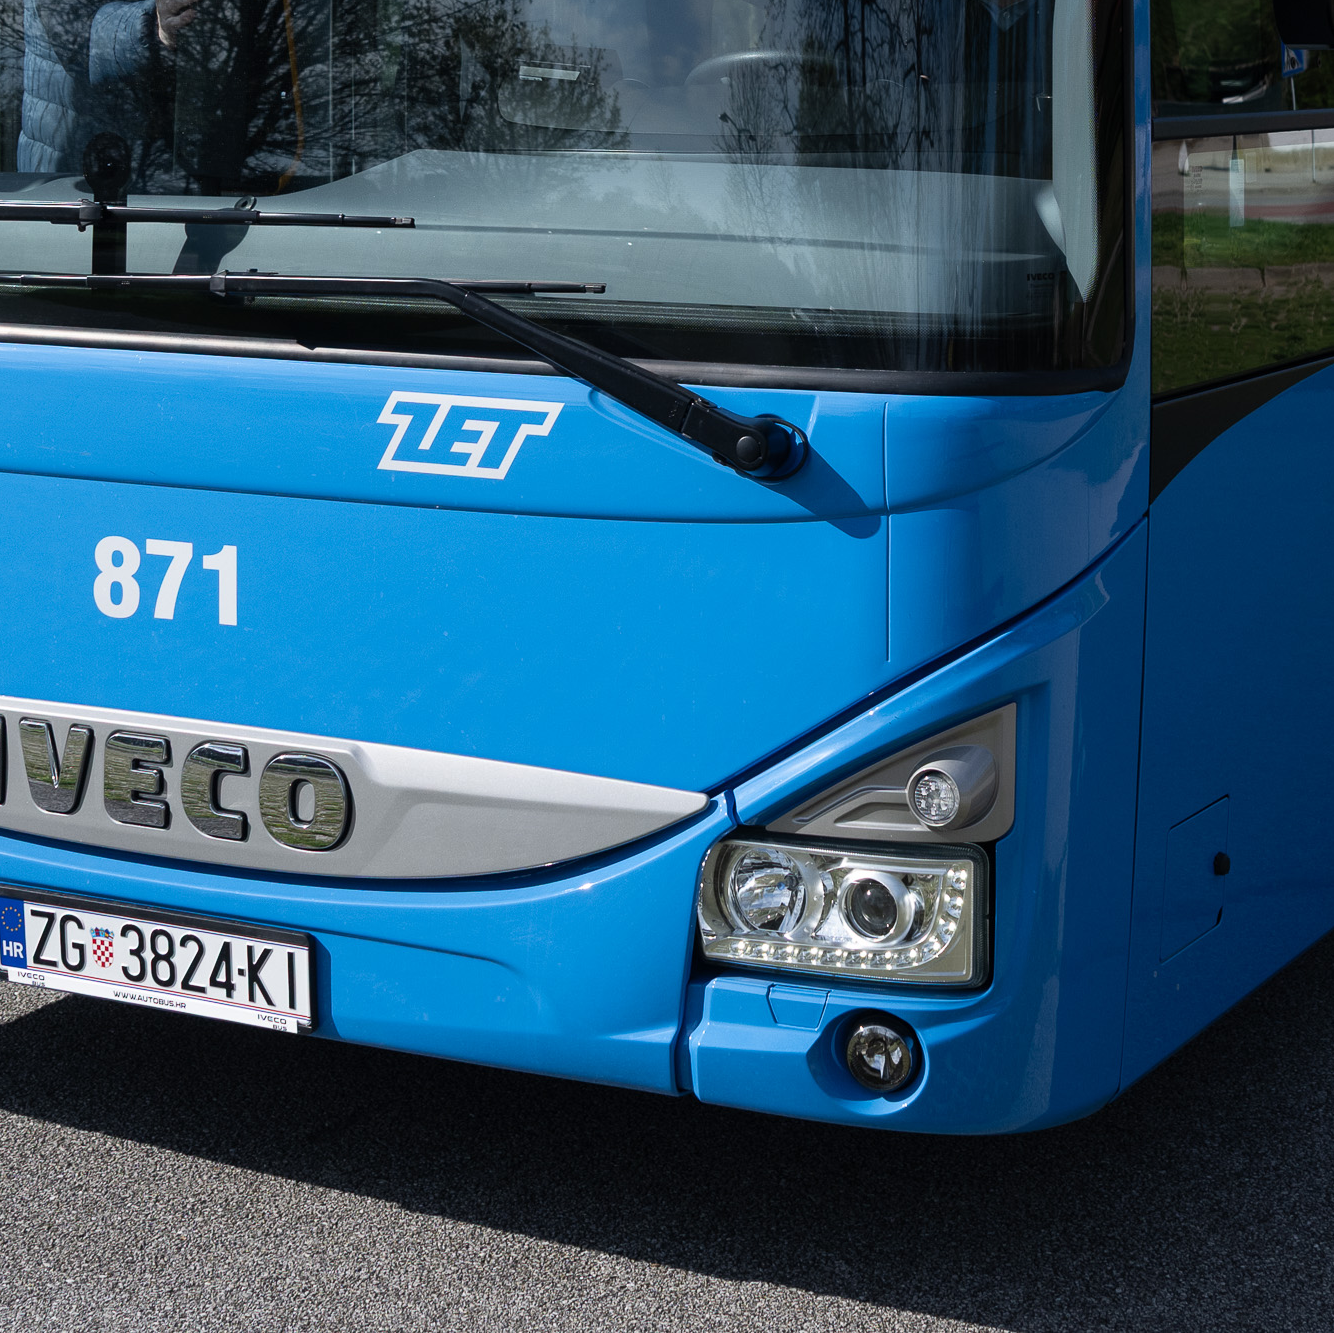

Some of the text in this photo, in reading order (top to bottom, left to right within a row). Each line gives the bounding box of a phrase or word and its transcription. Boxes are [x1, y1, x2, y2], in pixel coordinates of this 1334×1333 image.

[1026, 272, 1055, 281] IVECO
[376, 390, 565, 480] ZET
[93, 535, 239, 627] 871
[30, 909, 85, 972] ZG
[2, 939, 24, 959] HR
[17, 970, 45, 981] IVECO
[31, 980, 46, 988] BUS
[113, 990, 187, 1010] WWW.AUTOBUS.HR
[257, 1013, 287, 1025] IVECO
[272, 1024, 288, 1032] BUS
